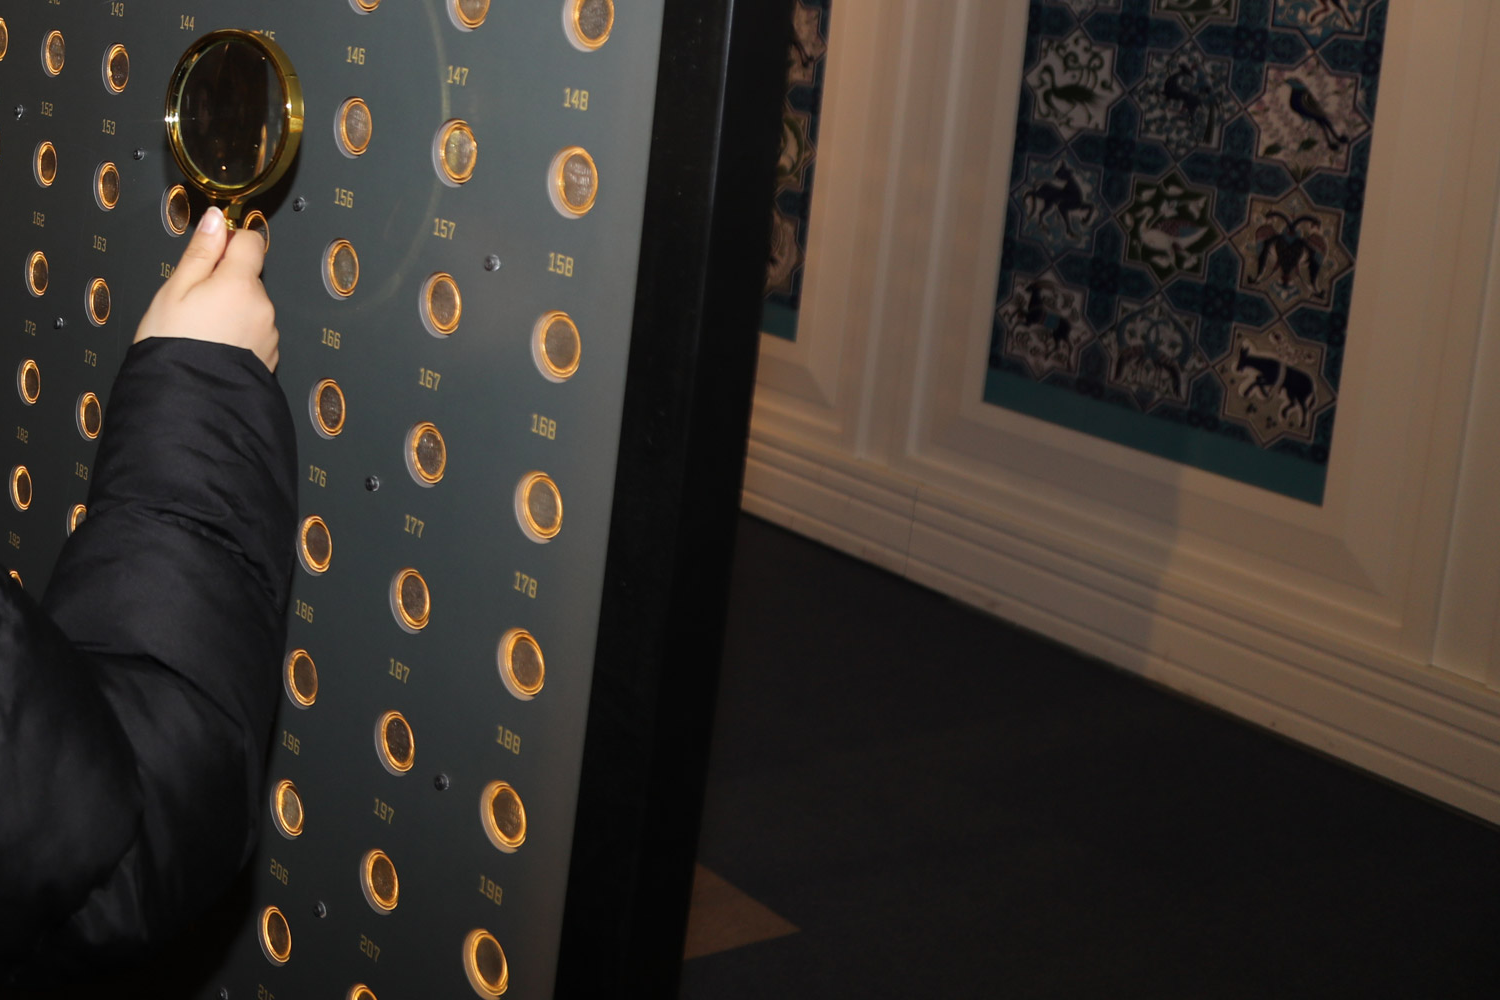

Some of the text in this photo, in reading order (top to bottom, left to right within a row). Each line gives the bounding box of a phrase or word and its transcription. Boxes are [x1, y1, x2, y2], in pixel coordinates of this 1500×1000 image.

[110, 1, 125, 18] 143
[179, 14, 194, 31] 144
[345, 45, 367, 66] 146
[445, 64, 471, 86] 147
[40, 100, 55, 118] 152
[563, 87, 591, 112] 148
[100, 118, 117, 137] 153
[334, 187, 355, 209] 156
[32, 210, 46, 228] 162
[432, 217, 457, 240] 157
[91, 234, 108, 254] 163
[547, 251, 575, 278] 158
[23, 319, 37, 337] 172
[321, 327, 342, 351] 166
[83, 348, 98, 368] 173
[418, 367, 442, 392] 167
[15, 425, 30, 445] 182
[531, 413, 558, 441] 168
[74, 461, 90, 481] 183
[308, 464, 328, 489] 176
[403, 513, 426, 538] 177
[8, 531, 21, 550] 192
[513, 570, 539, 599] 178
[294, 599, 315, 624] 186
[388, 657, 412, 684] 187
[282, 730, 301, 756] 196
[496, 724, 522, 756] 188
[373, 796, 397, 825] 197
[269, 858, 290, 886] 206
[478, 874, 504, 906] 198
[359, 933, 382, 961] 207
